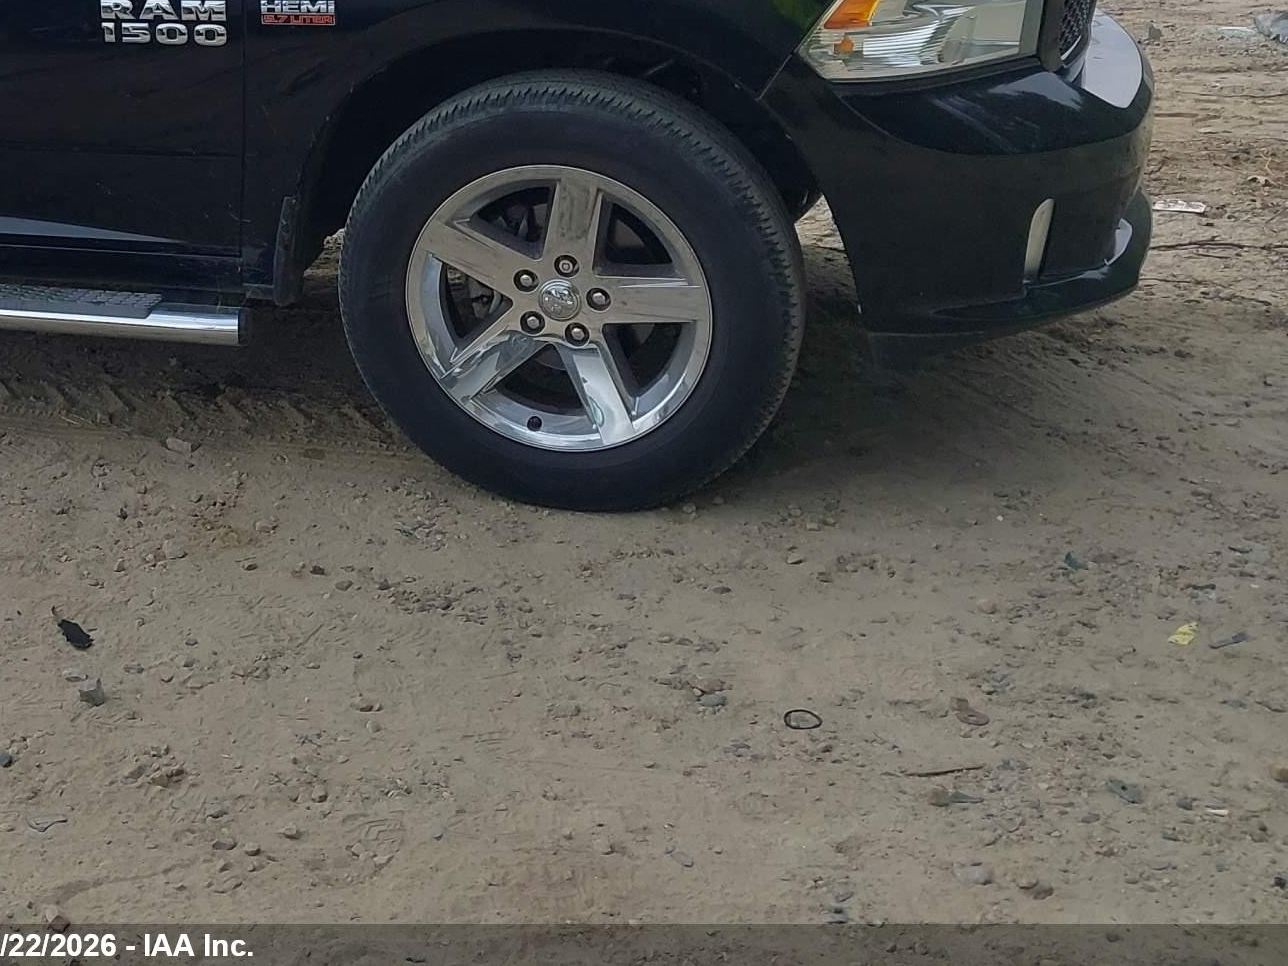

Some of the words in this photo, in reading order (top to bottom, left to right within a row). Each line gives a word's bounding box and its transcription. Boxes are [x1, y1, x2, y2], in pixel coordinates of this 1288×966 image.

[260, 0, 335, 13] HEMI
[291, 15, 333, 24] LITER
[101, 22, 227, 46] 1500
